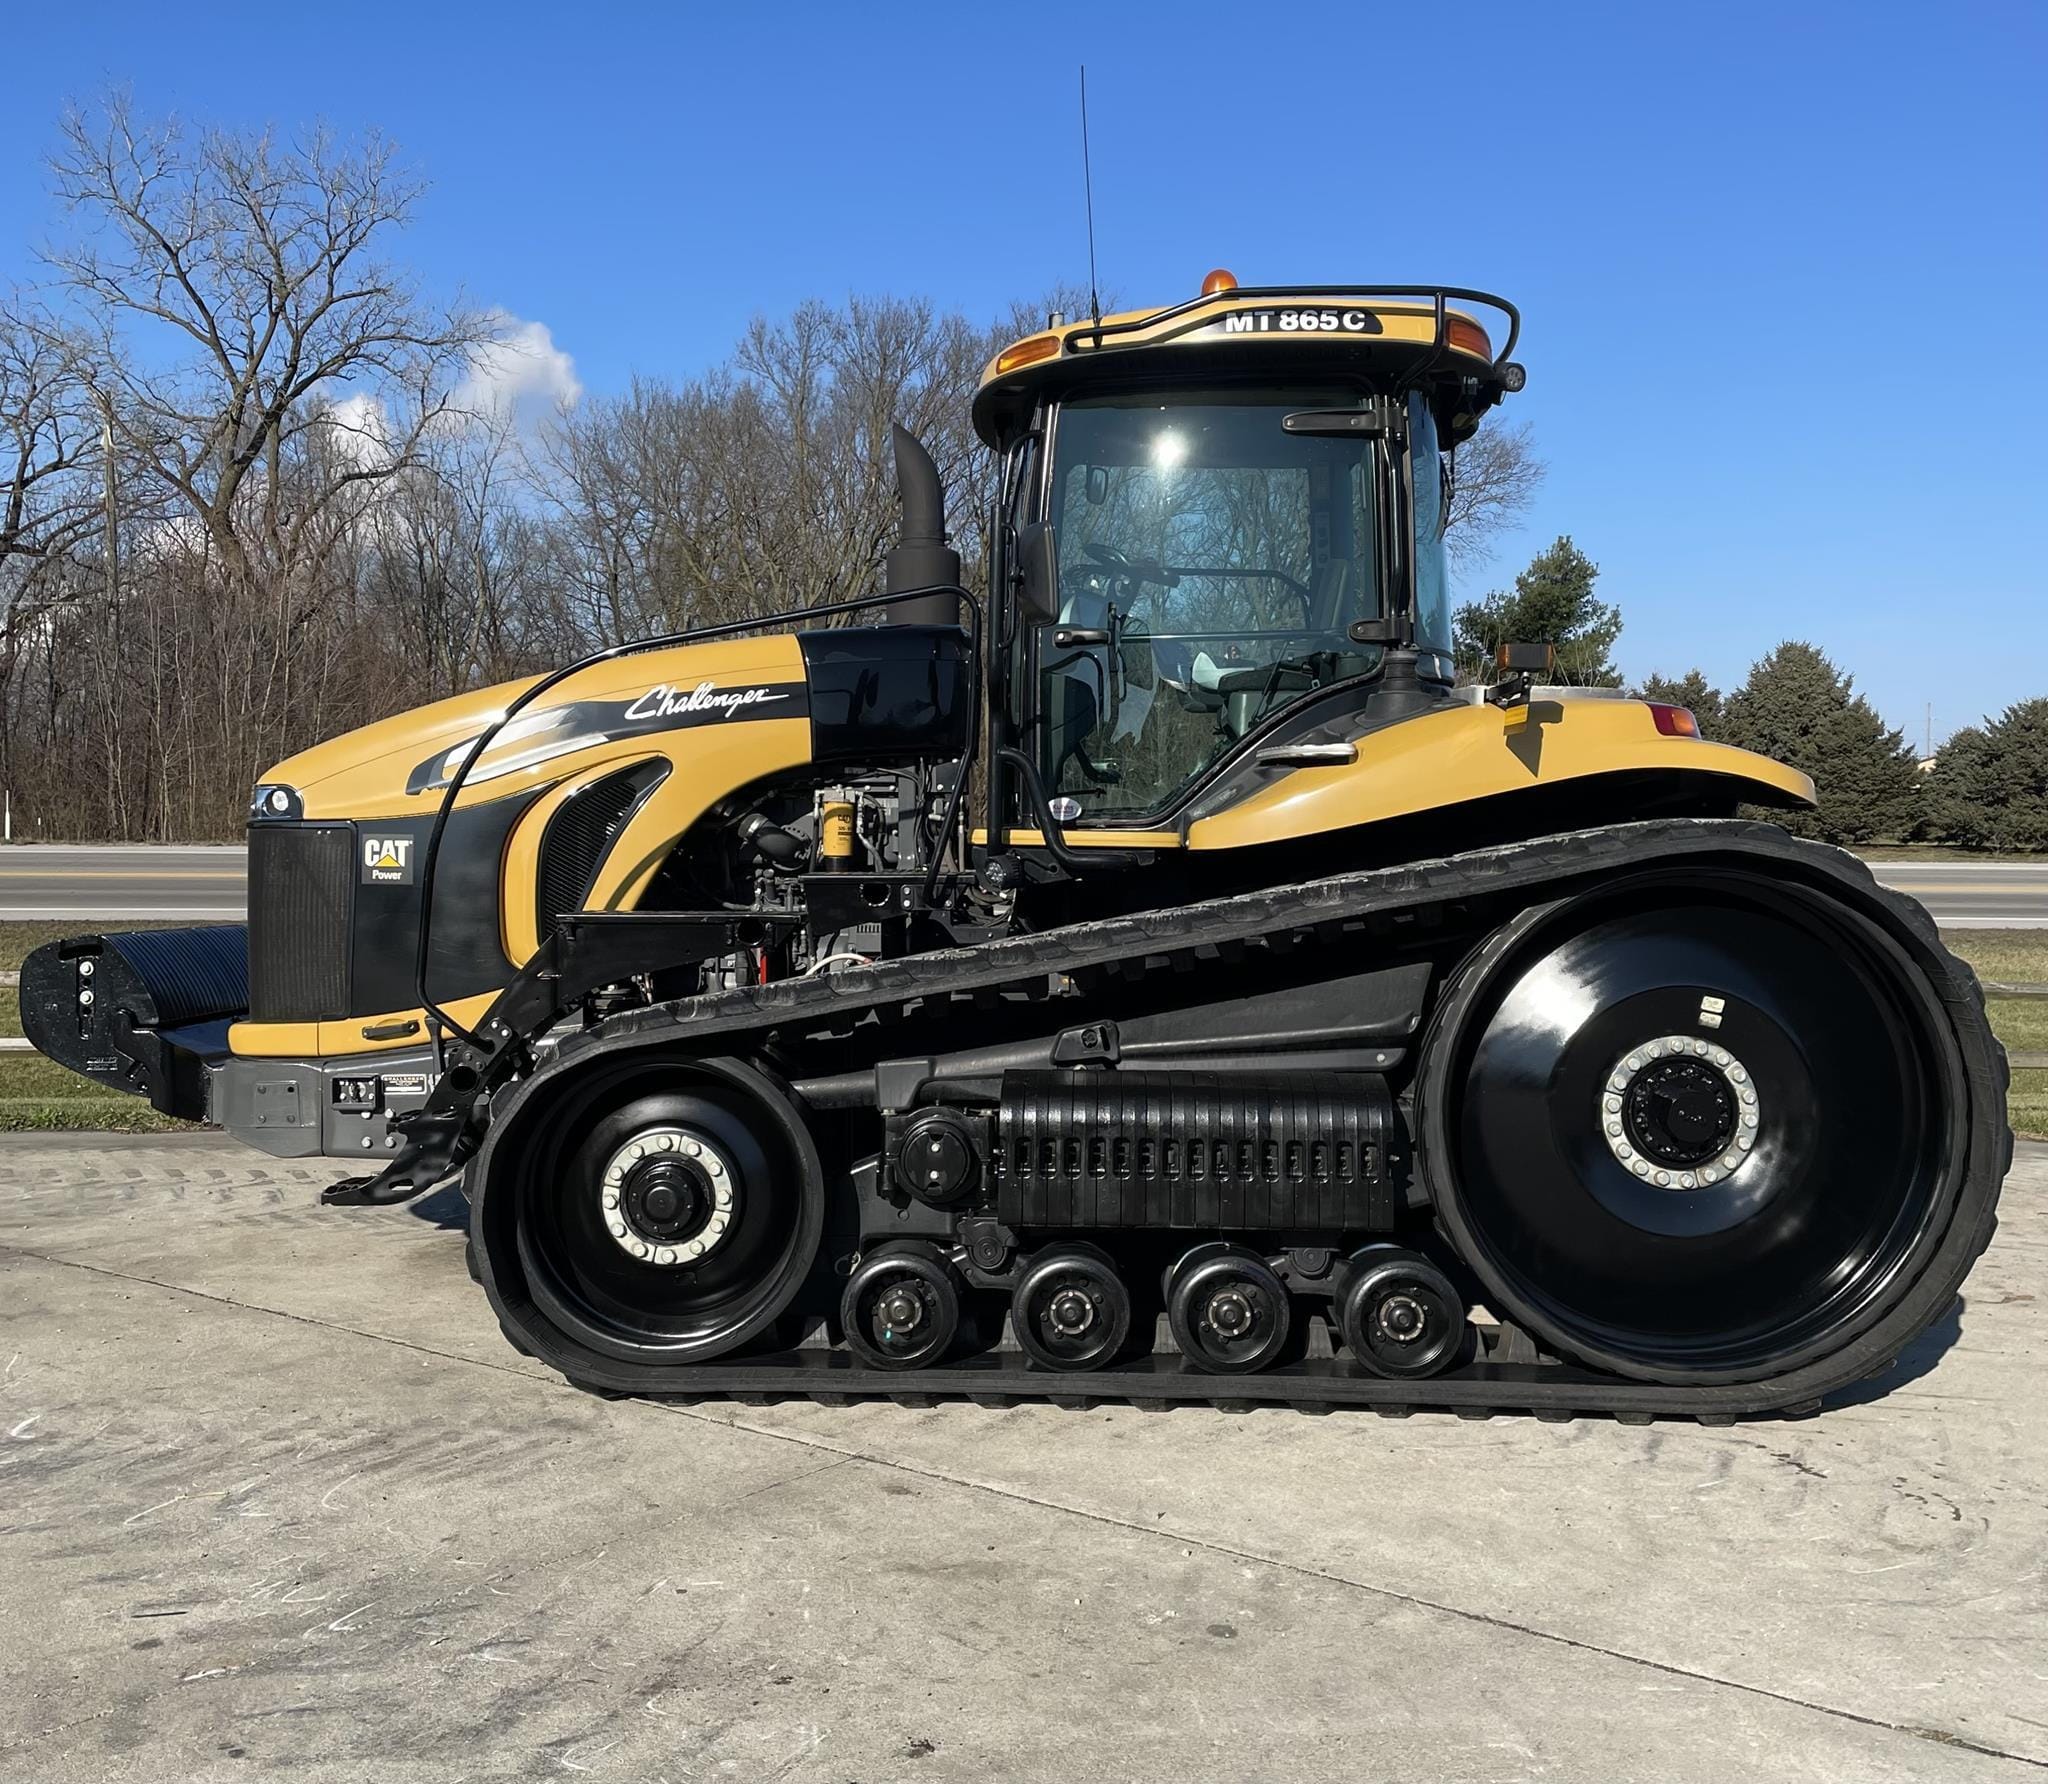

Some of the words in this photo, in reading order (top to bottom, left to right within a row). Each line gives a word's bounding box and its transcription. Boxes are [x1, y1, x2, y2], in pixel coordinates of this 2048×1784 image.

[624, 681, 790, 720] Challenger
[364, 839, 411, 867] CAT
[372, 869, 402, 880] Power
